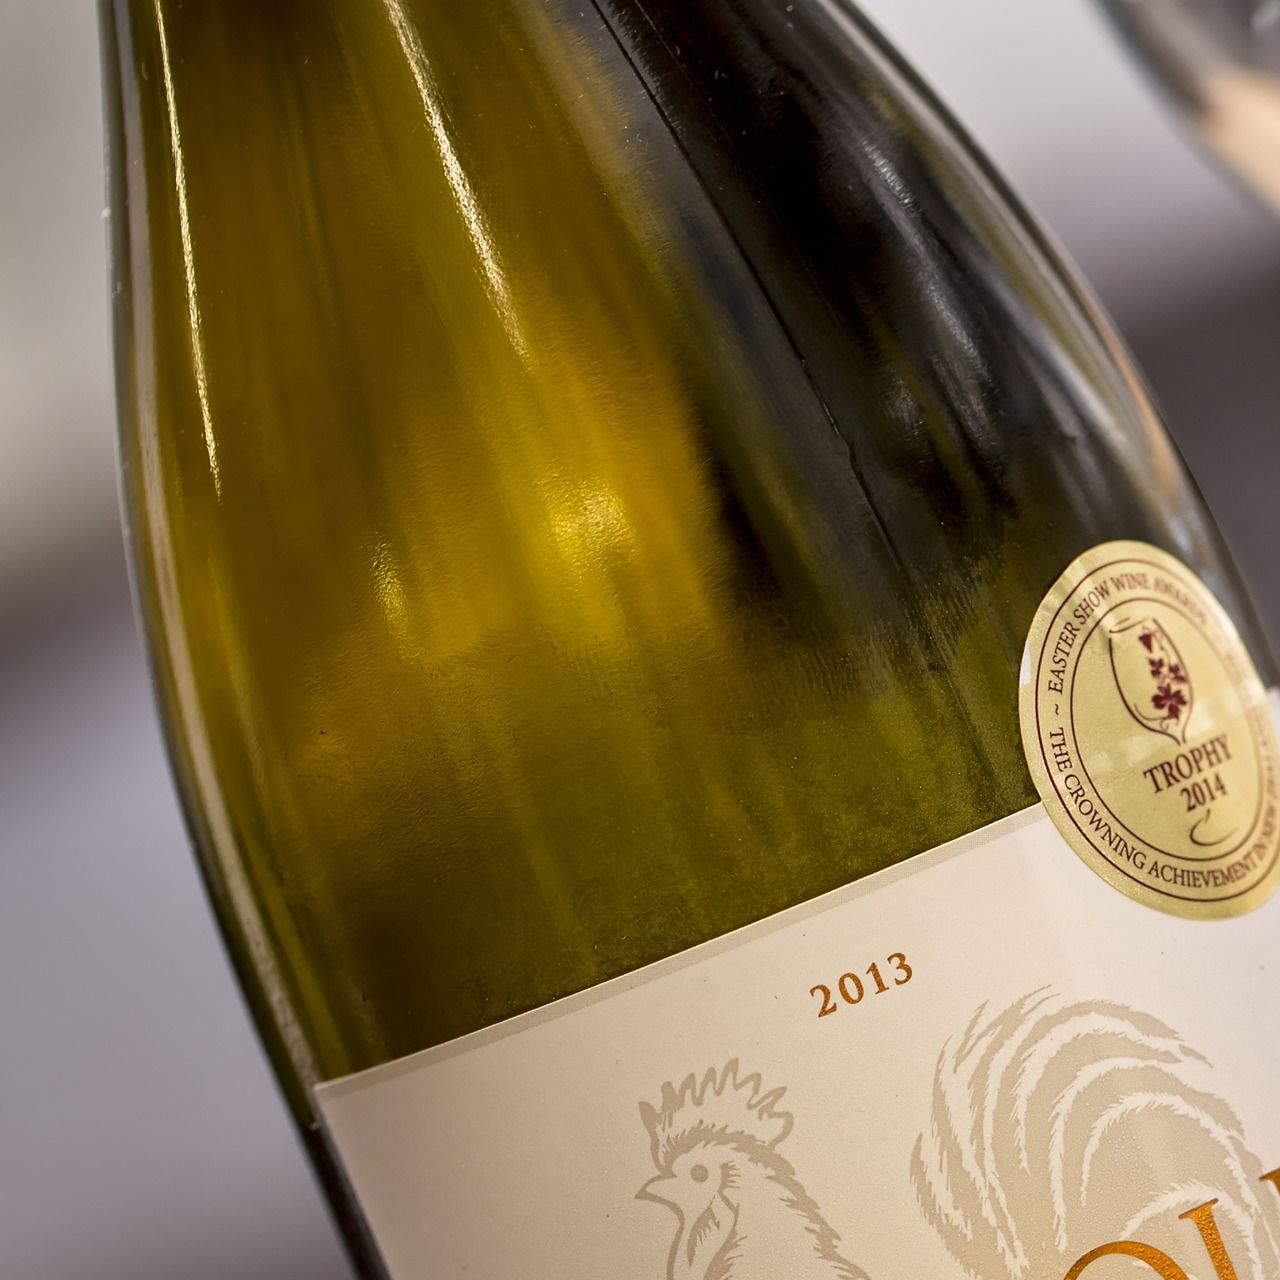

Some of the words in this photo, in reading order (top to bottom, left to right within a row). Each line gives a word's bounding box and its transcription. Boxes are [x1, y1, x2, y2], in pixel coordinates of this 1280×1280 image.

[1048, 622, 1081, 695] EASTER
[1073, 580, 1110, 625] SHOW
[1110, 573, 1151, 592] WINE
[1143, 733, 1231, 793] TROPHY
[1180, 773, 1227, 812] 2014
[1049, 727, 1073, 772] THE
[1064, 774, 1147, 870] CROWNING
[1148, 850, 1258, 888] ACHIEVEMENT
[809, 951, 915, 1018] 2013
